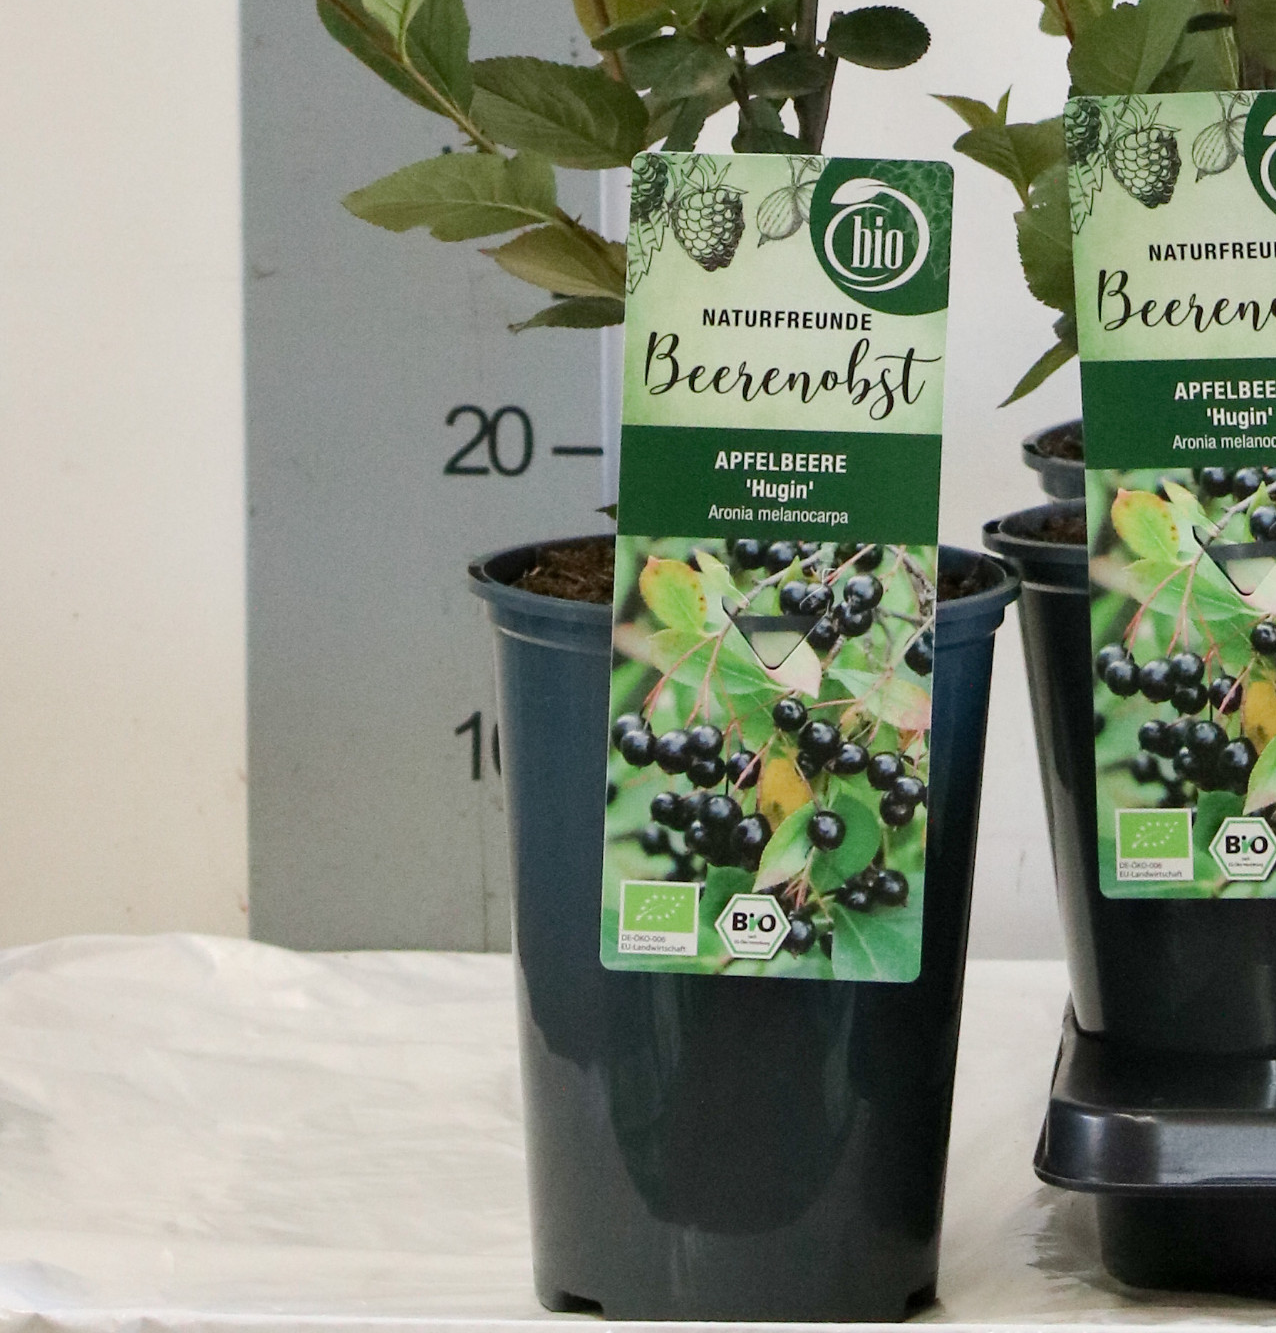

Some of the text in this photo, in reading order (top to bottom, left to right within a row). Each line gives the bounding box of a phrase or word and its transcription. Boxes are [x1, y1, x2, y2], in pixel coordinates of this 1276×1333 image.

[851, 215, 905, 271] bio
[702, 308, 873, 331] NATURFREUNDE
[644, 332, 943, 420] Beerenobst
[1206, 407, 1273, 429] 'Hugin'
[443, 403, 534, 477] 20
[1172, 433, 1217, 450] Aronia
[714, 450, 848, 474] APFELBEERE
[746, 479, 814, 502] 'Hugin'
[708, 504, 849, 526] Aronia melanocarpa
[455, 710, 502, 781] 1
